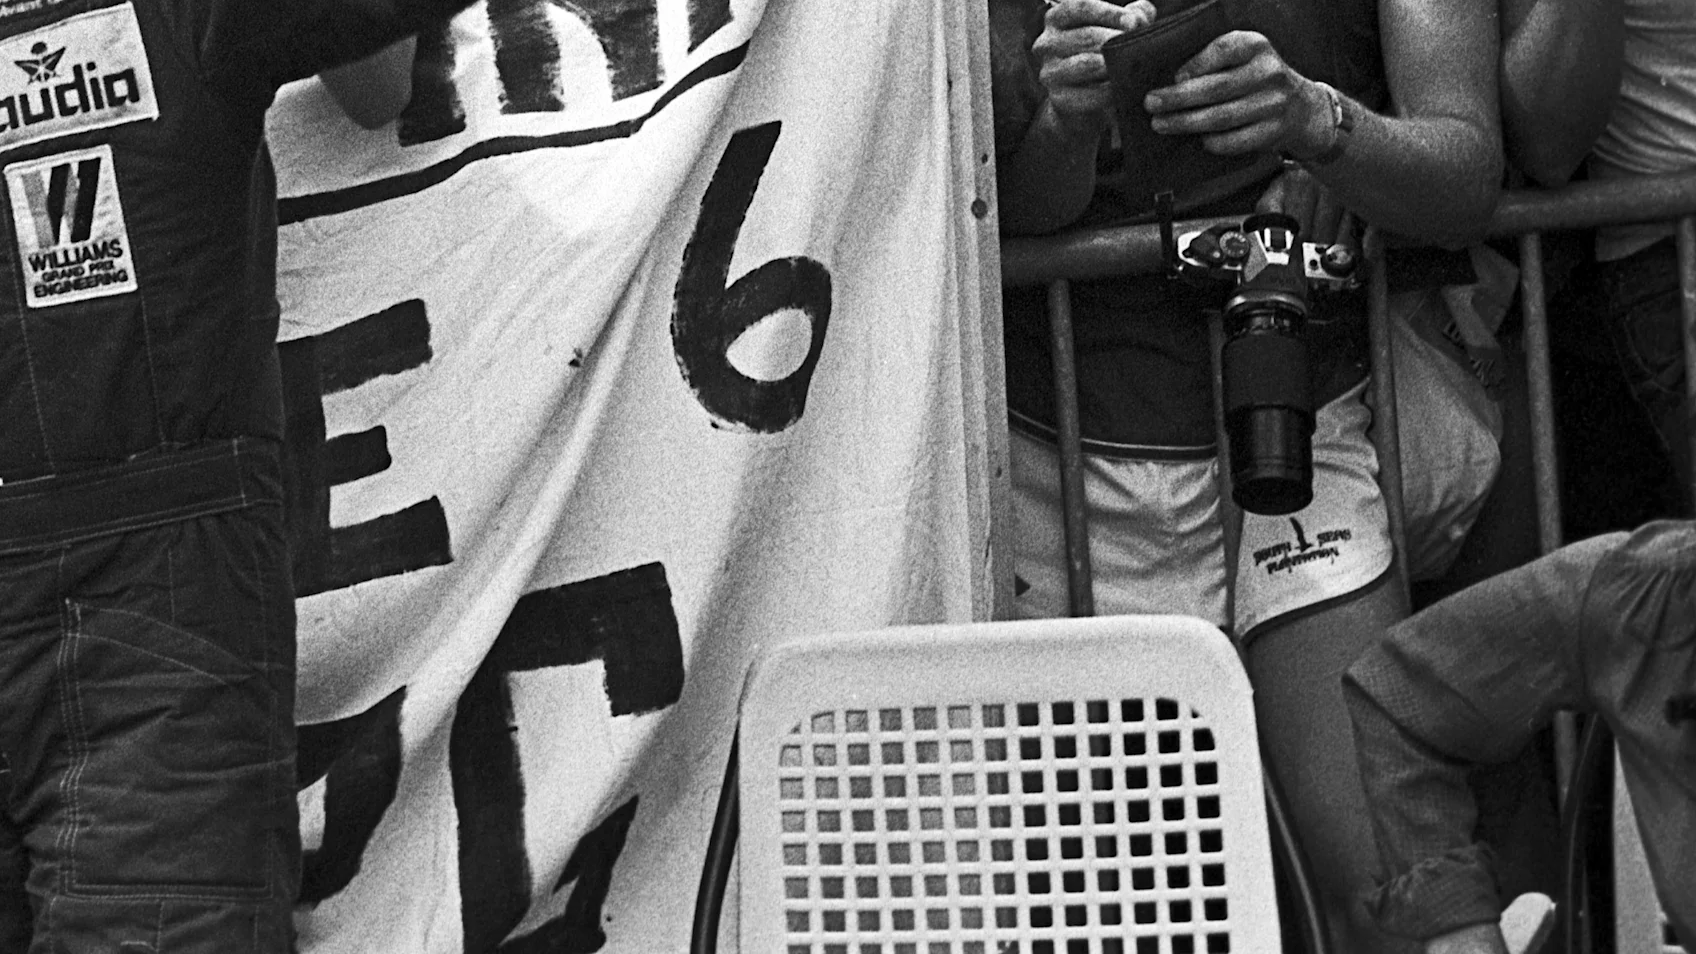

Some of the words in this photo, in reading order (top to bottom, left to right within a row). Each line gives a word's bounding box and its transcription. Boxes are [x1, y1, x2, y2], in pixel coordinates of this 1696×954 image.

[28, 238, 123, 272] WILLIAMS
[33, 268, 128, 298] ENGINEERING
[42, 265, 85, 282] GRAND
[671, 120, 832, 435] 6
